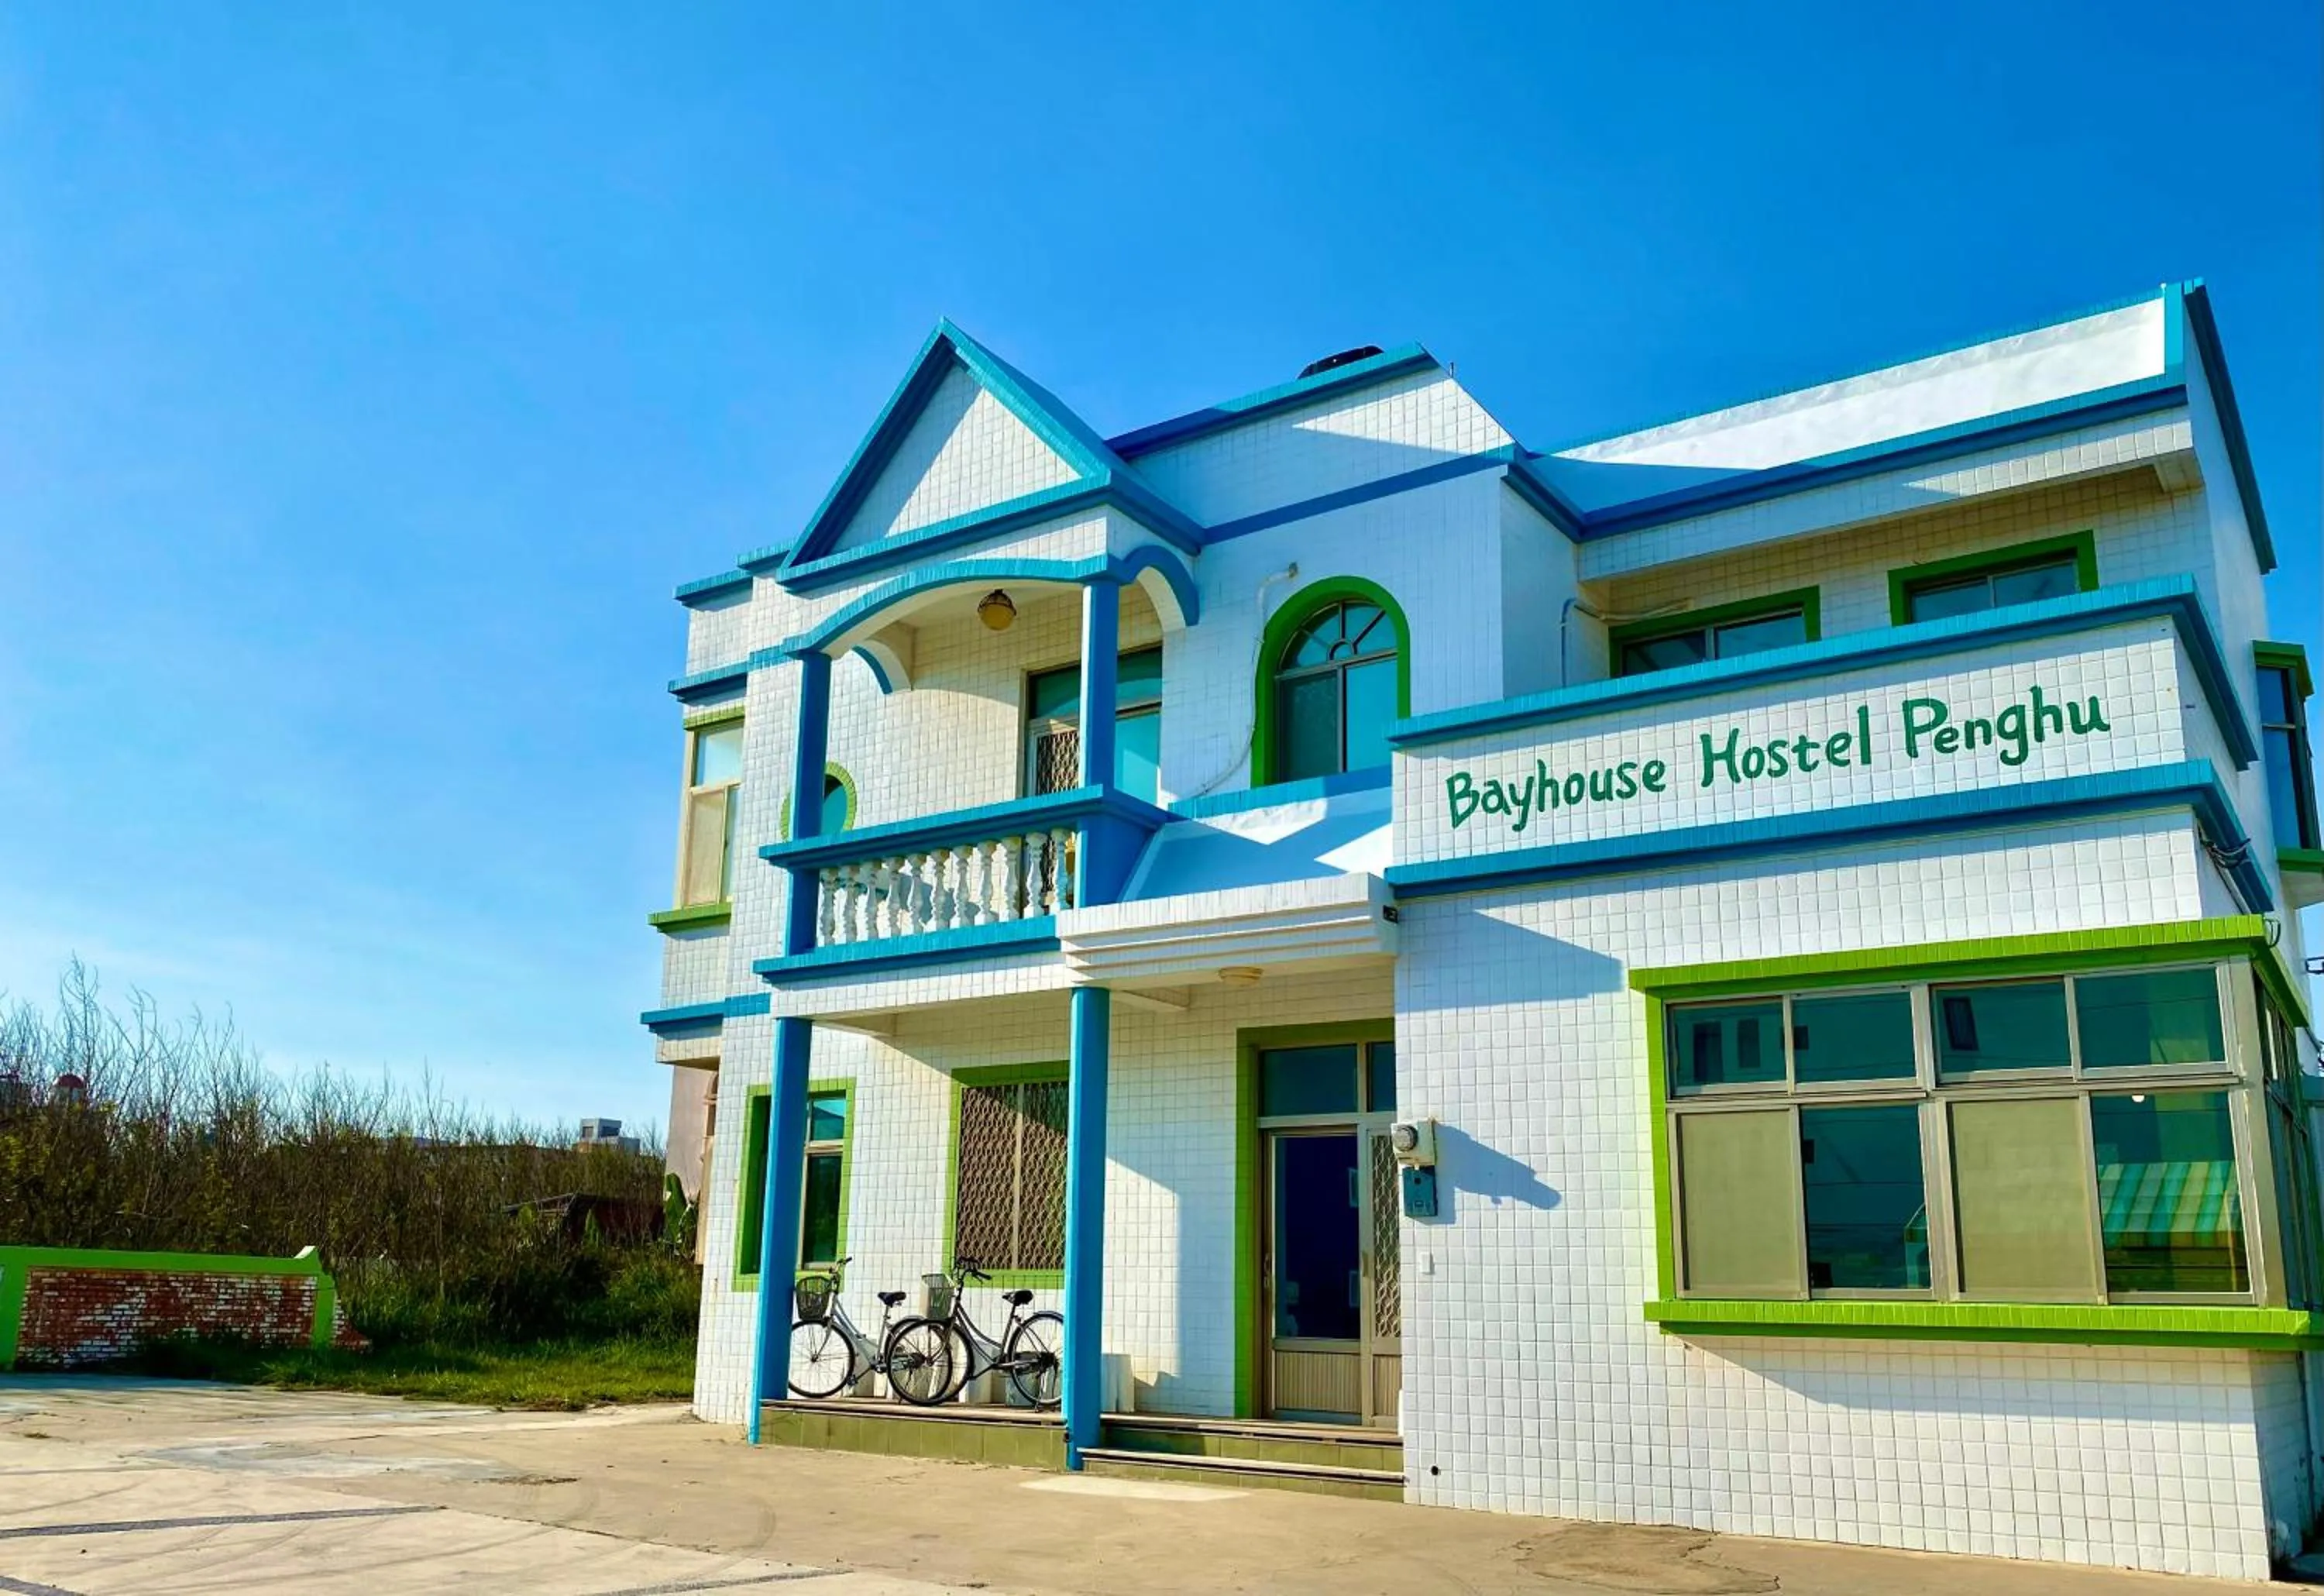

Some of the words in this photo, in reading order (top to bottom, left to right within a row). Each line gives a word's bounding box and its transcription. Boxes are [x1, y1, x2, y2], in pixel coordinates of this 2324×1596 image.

[1446, 758, 1666, 831] Bayhouse
[1700, 706, 1872, 787] Hostel
[1902, 686, 2110, 765] Penghu
